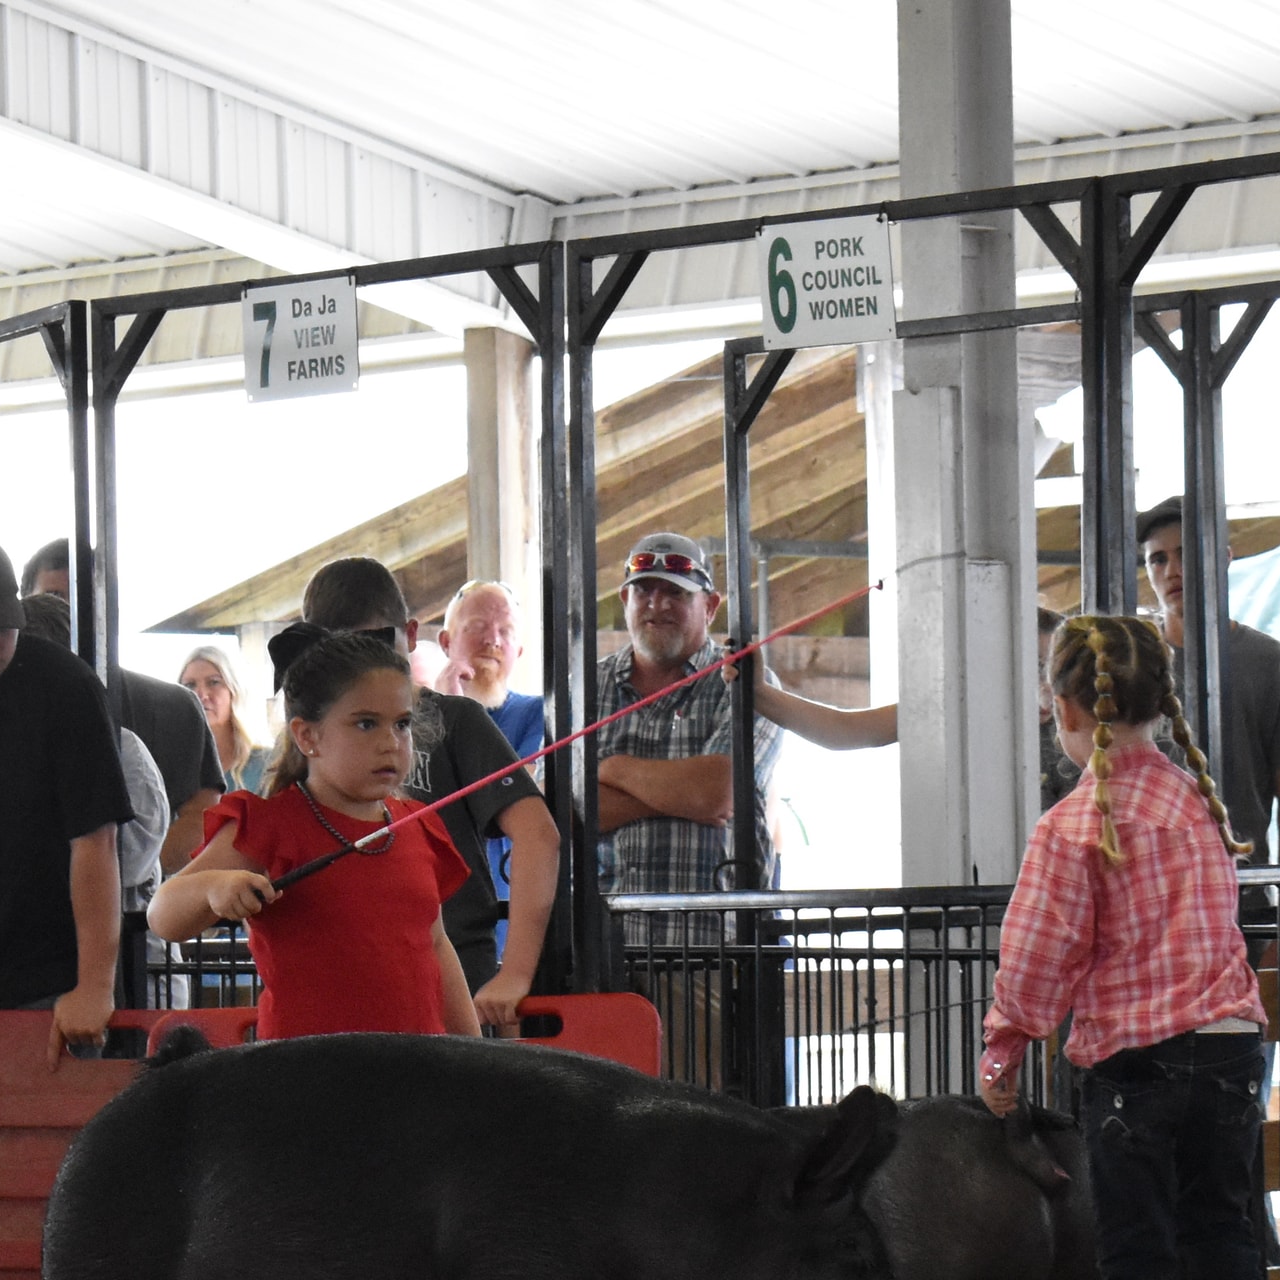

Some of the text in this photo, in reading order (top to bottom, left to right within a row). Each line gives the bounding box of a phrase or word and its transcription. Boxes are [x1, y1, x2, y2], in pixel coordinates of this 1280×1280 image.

[815, 236, 865, 260] PORK
[768, 236, 797, 334] 6
[802, 266, 882, 292] COUNCIL
[291, 294, 337, 318] Da Ja
[808, 296, 878, 321] WOMEN
[252, 300, 277, 389] 7
[293, 324, 336, 349] VIEW
[287, 354, 346, 381] FARMS
